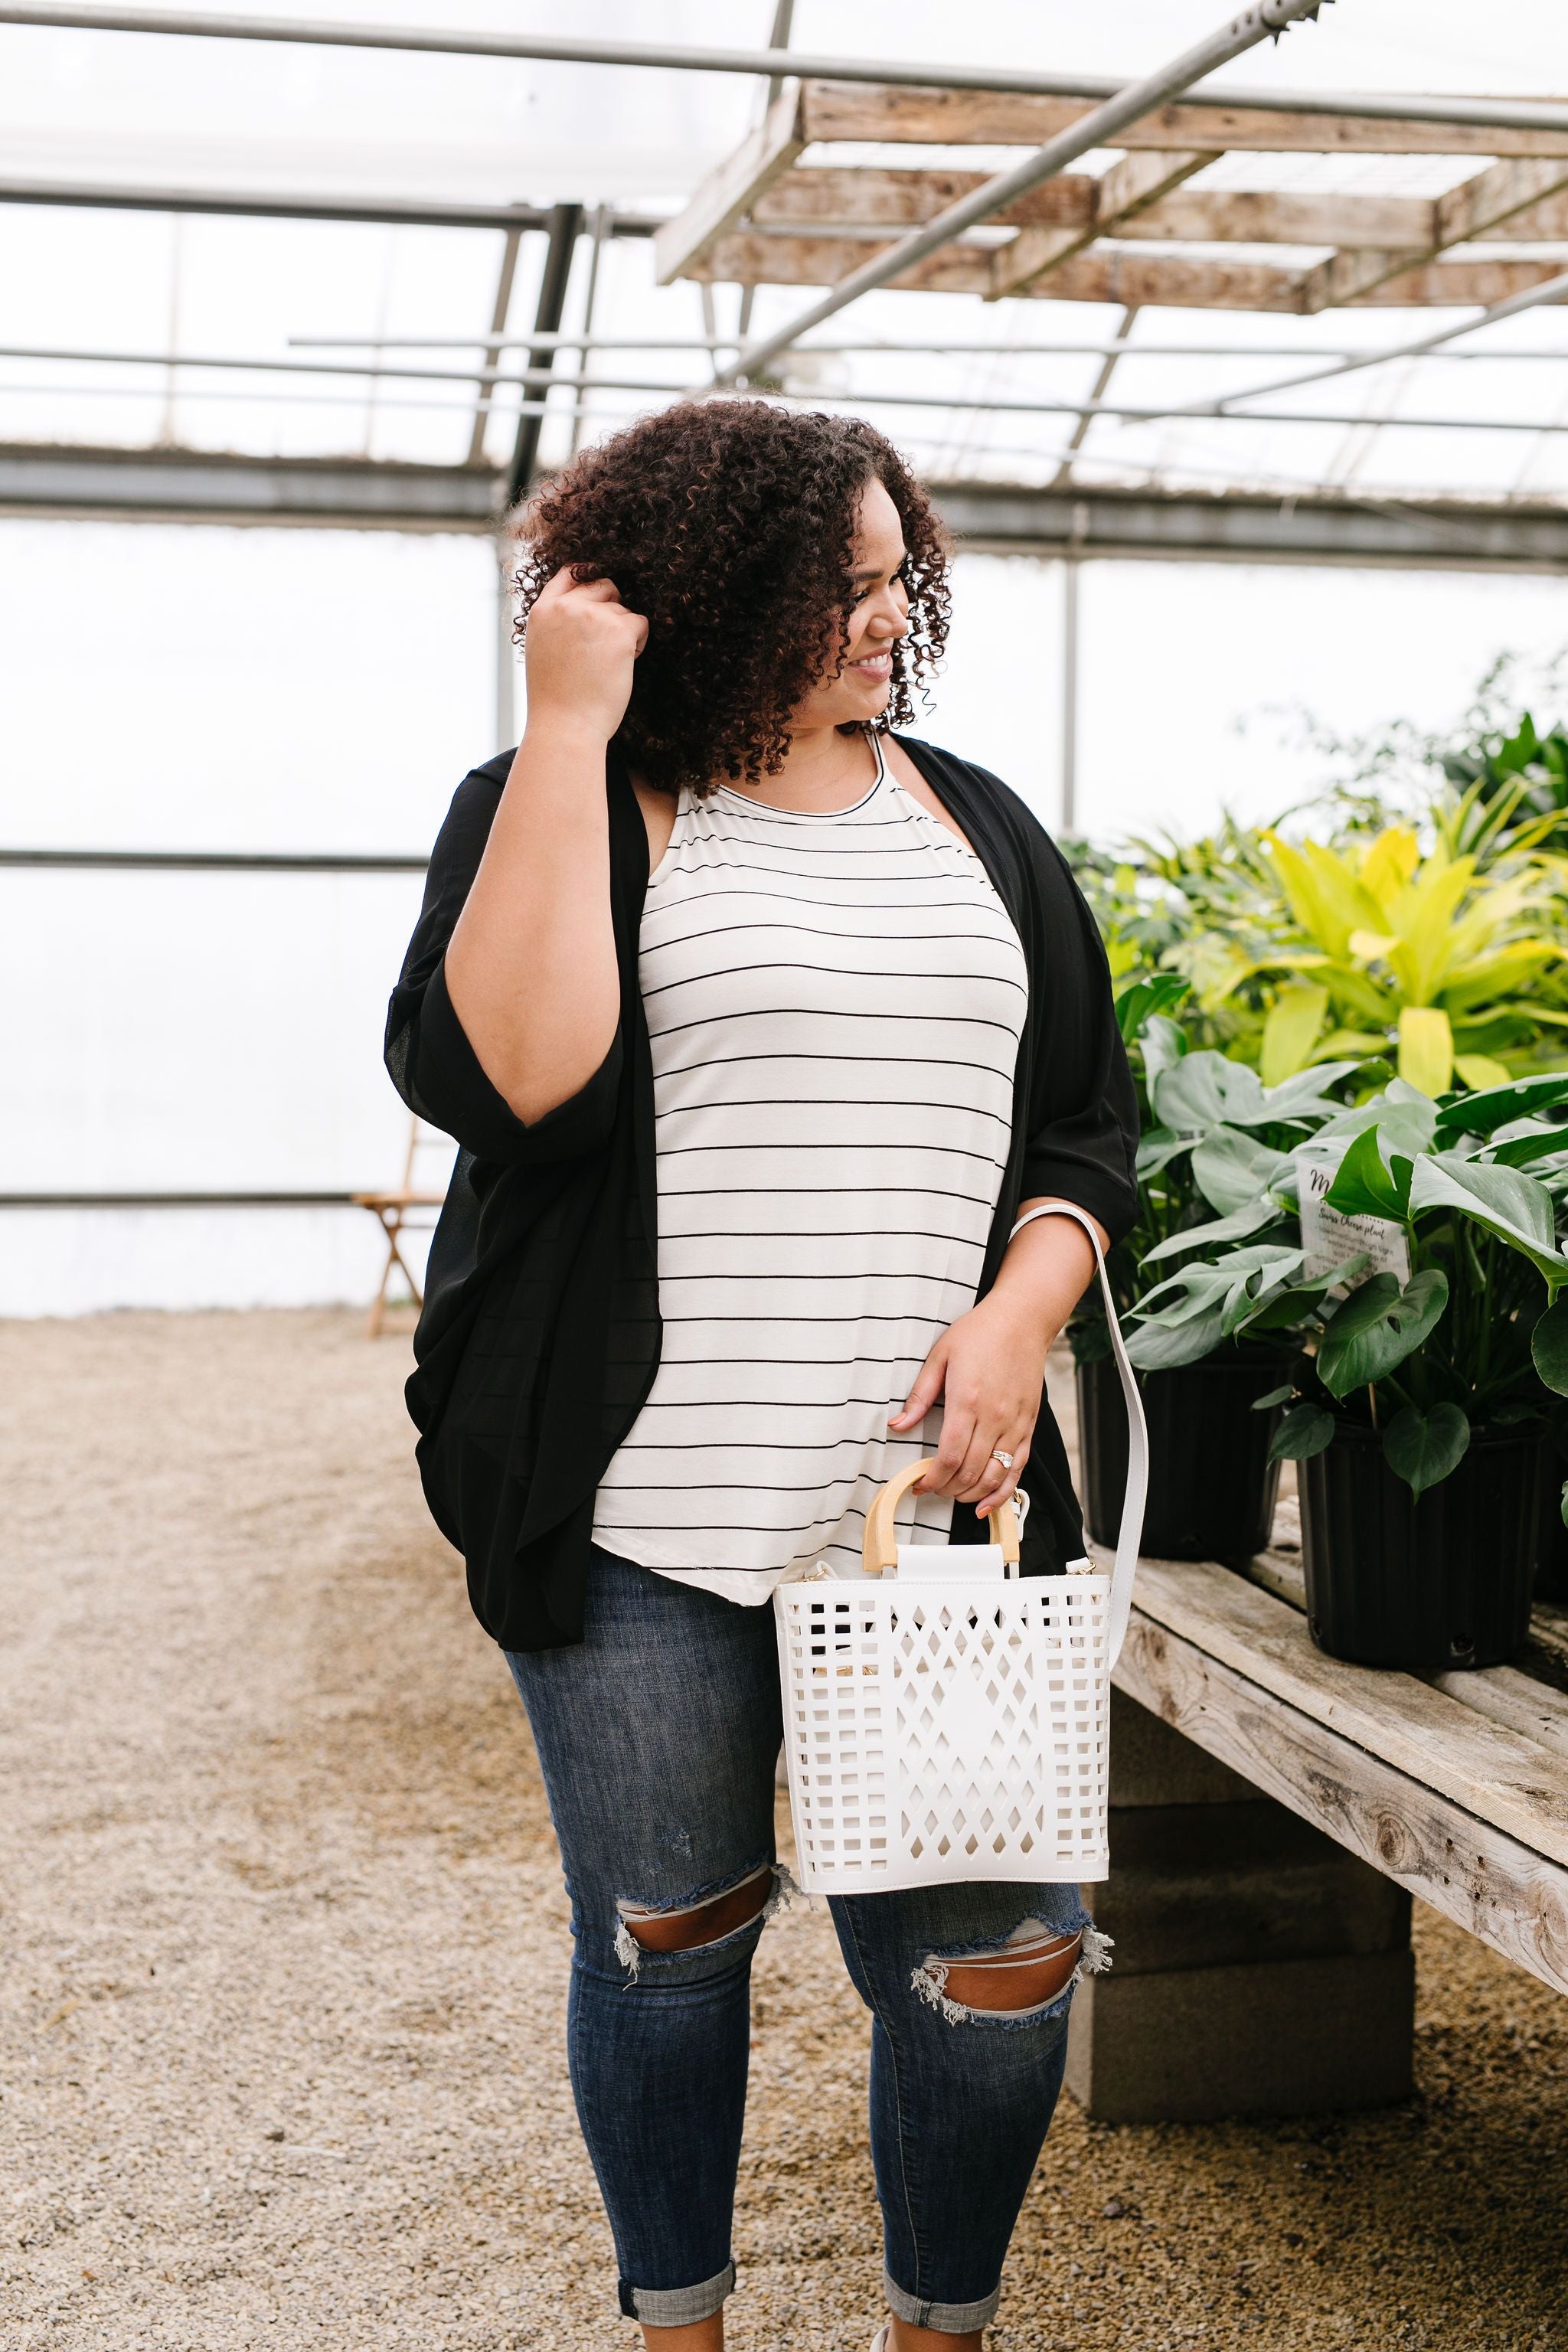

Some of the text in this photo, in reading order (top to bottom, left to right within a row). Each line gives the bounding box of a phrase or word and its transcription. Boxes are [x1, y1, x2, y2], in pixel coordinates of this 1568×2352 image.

[1310, 1169, 1330, 1194] M
[1318, 1207, 1338, 1223] Swiss
[1340, 1215, 1363, 1231] Cheese
